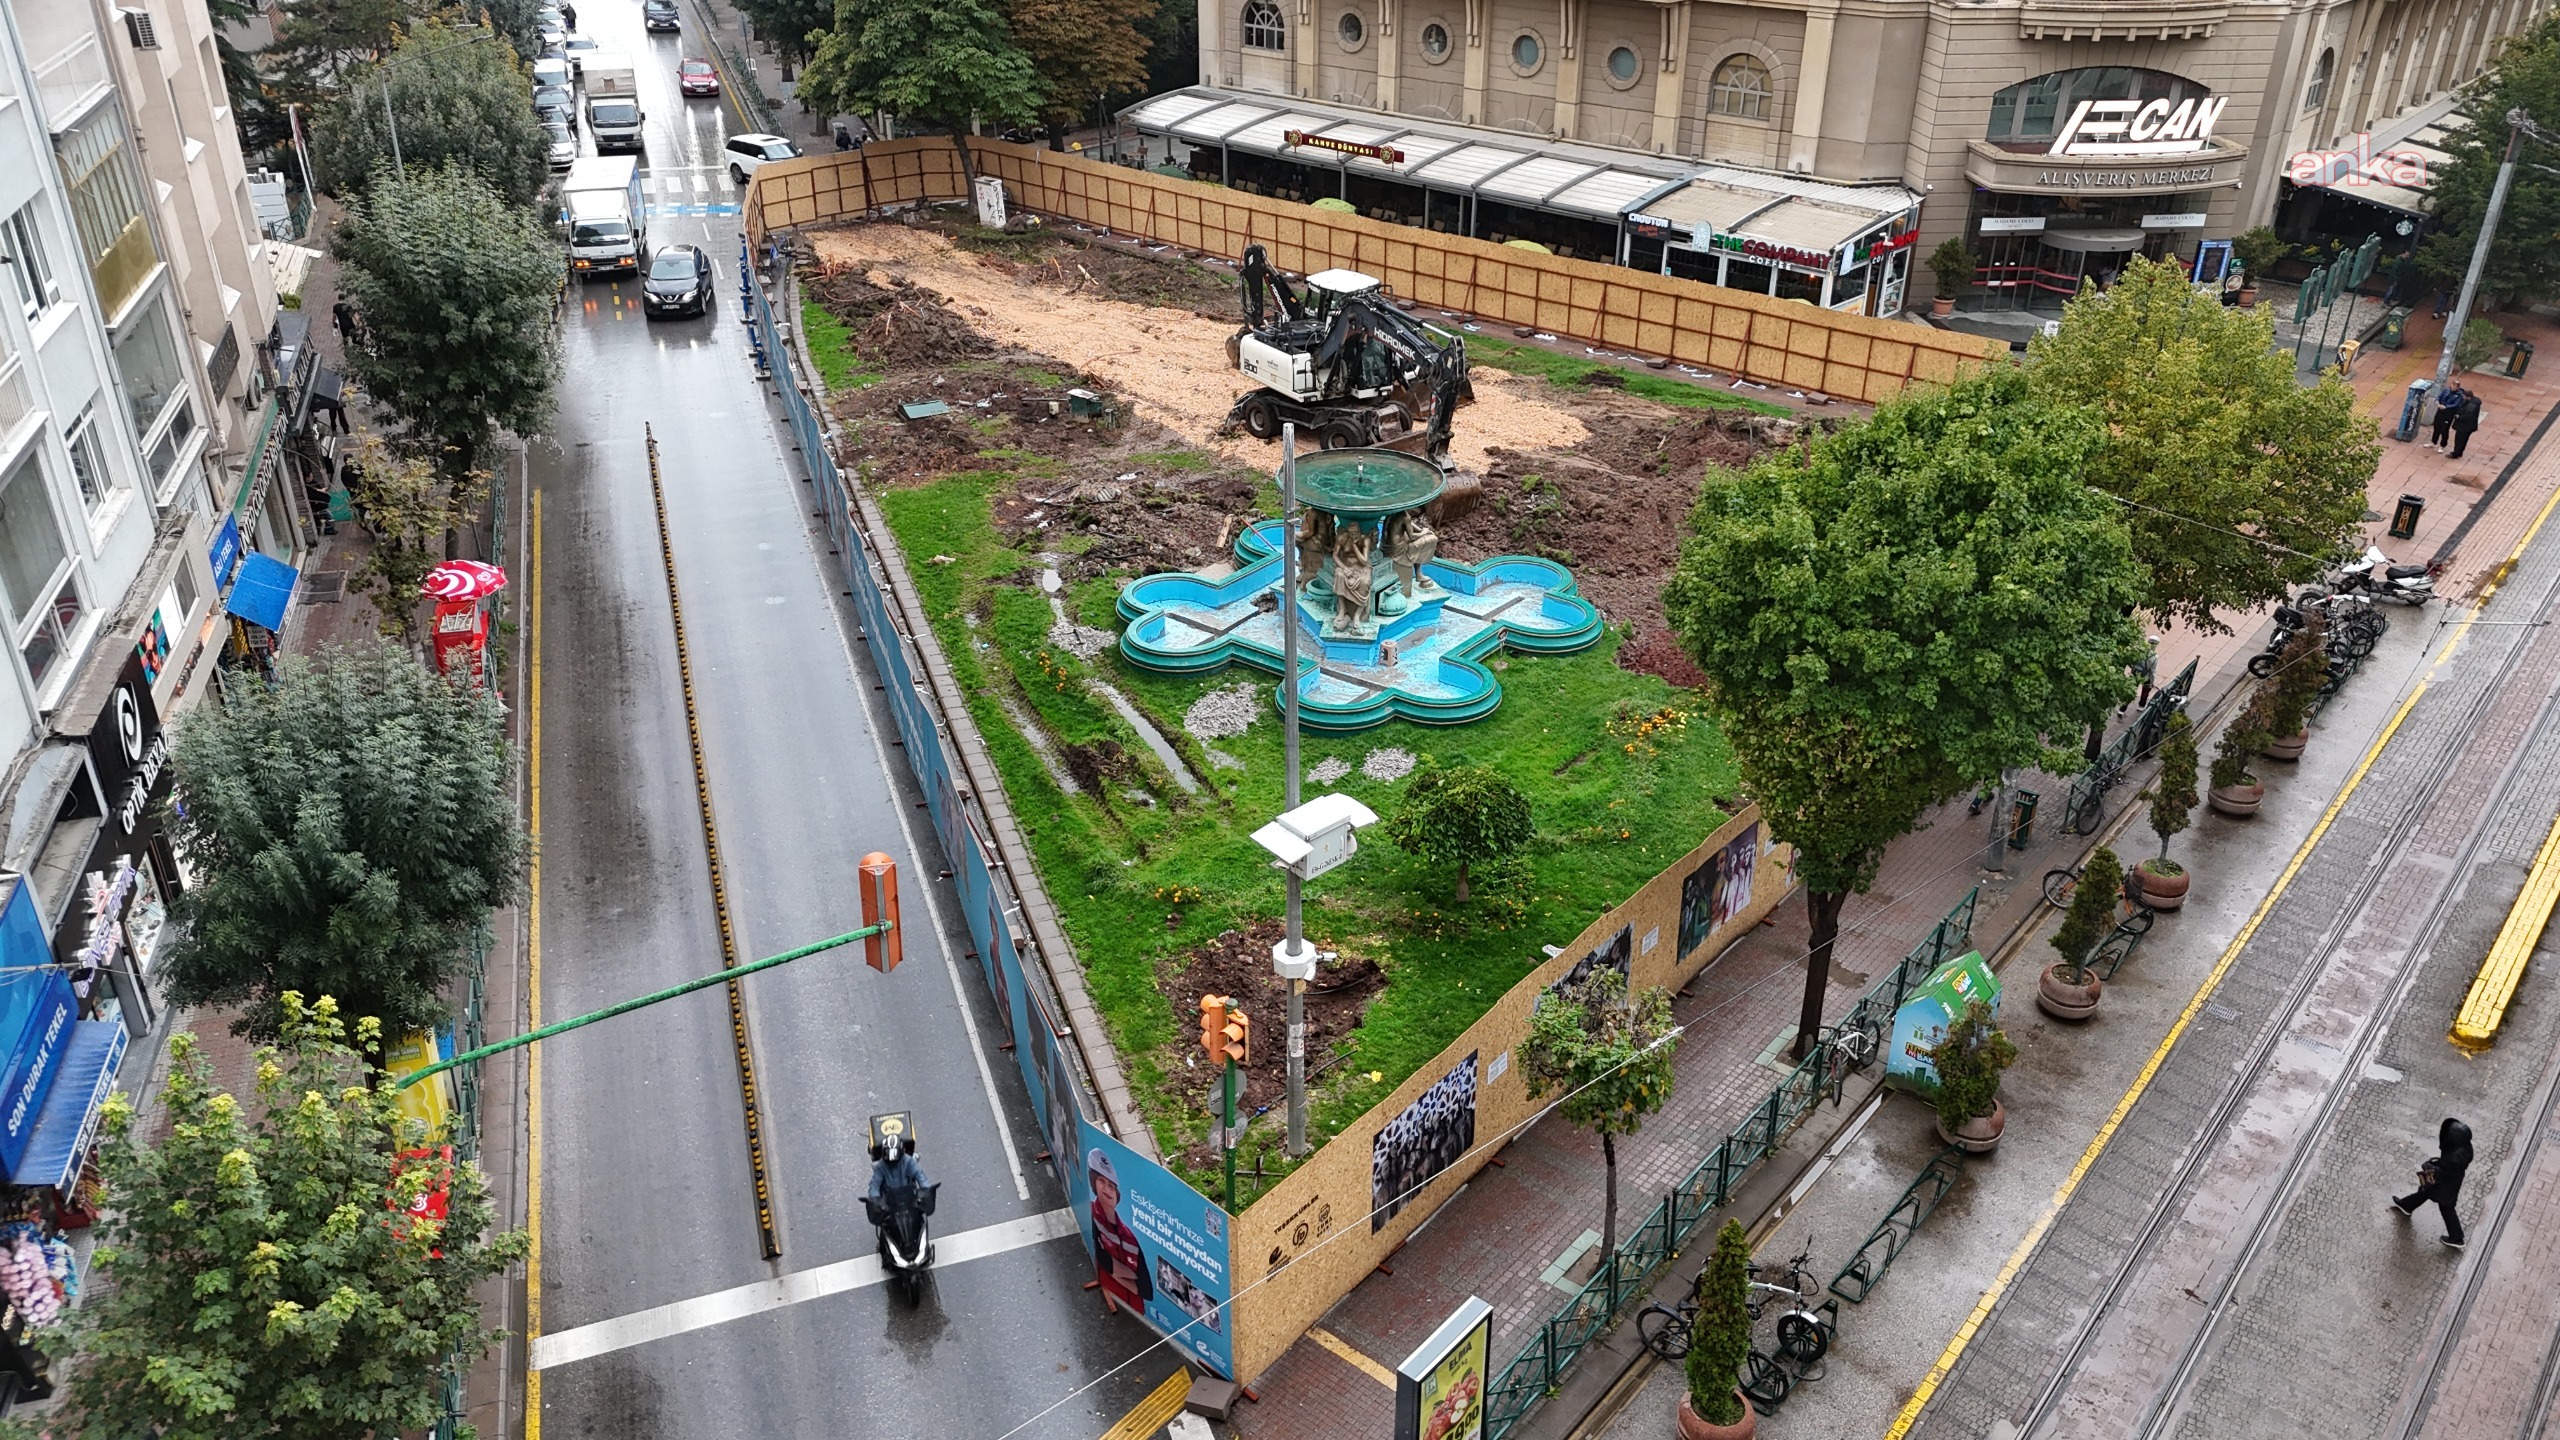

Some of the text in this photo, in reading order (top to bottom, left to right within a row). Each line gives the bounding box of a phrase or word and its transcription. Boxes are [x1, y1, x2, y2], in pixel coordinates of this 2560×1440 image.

[1308, 138, 1374, 155] KAHVE DÜNYASI
[2037, 165, 2216, 188] ALIŞVERİŞ MERKEZİ
[1715, 234, 1833, 270] THE COMPANY
[1749, 255, 1792, 271] COFFEE
[8, 1002, 68, 1137] SON DURAK TEKEL
[1131, 1204, 1223, 1273] yeni bir meydan
[1132, 1216, 1220, 1285] kazandırıyoruz.
[1448, 1341, 1473, 1372] ELMA
